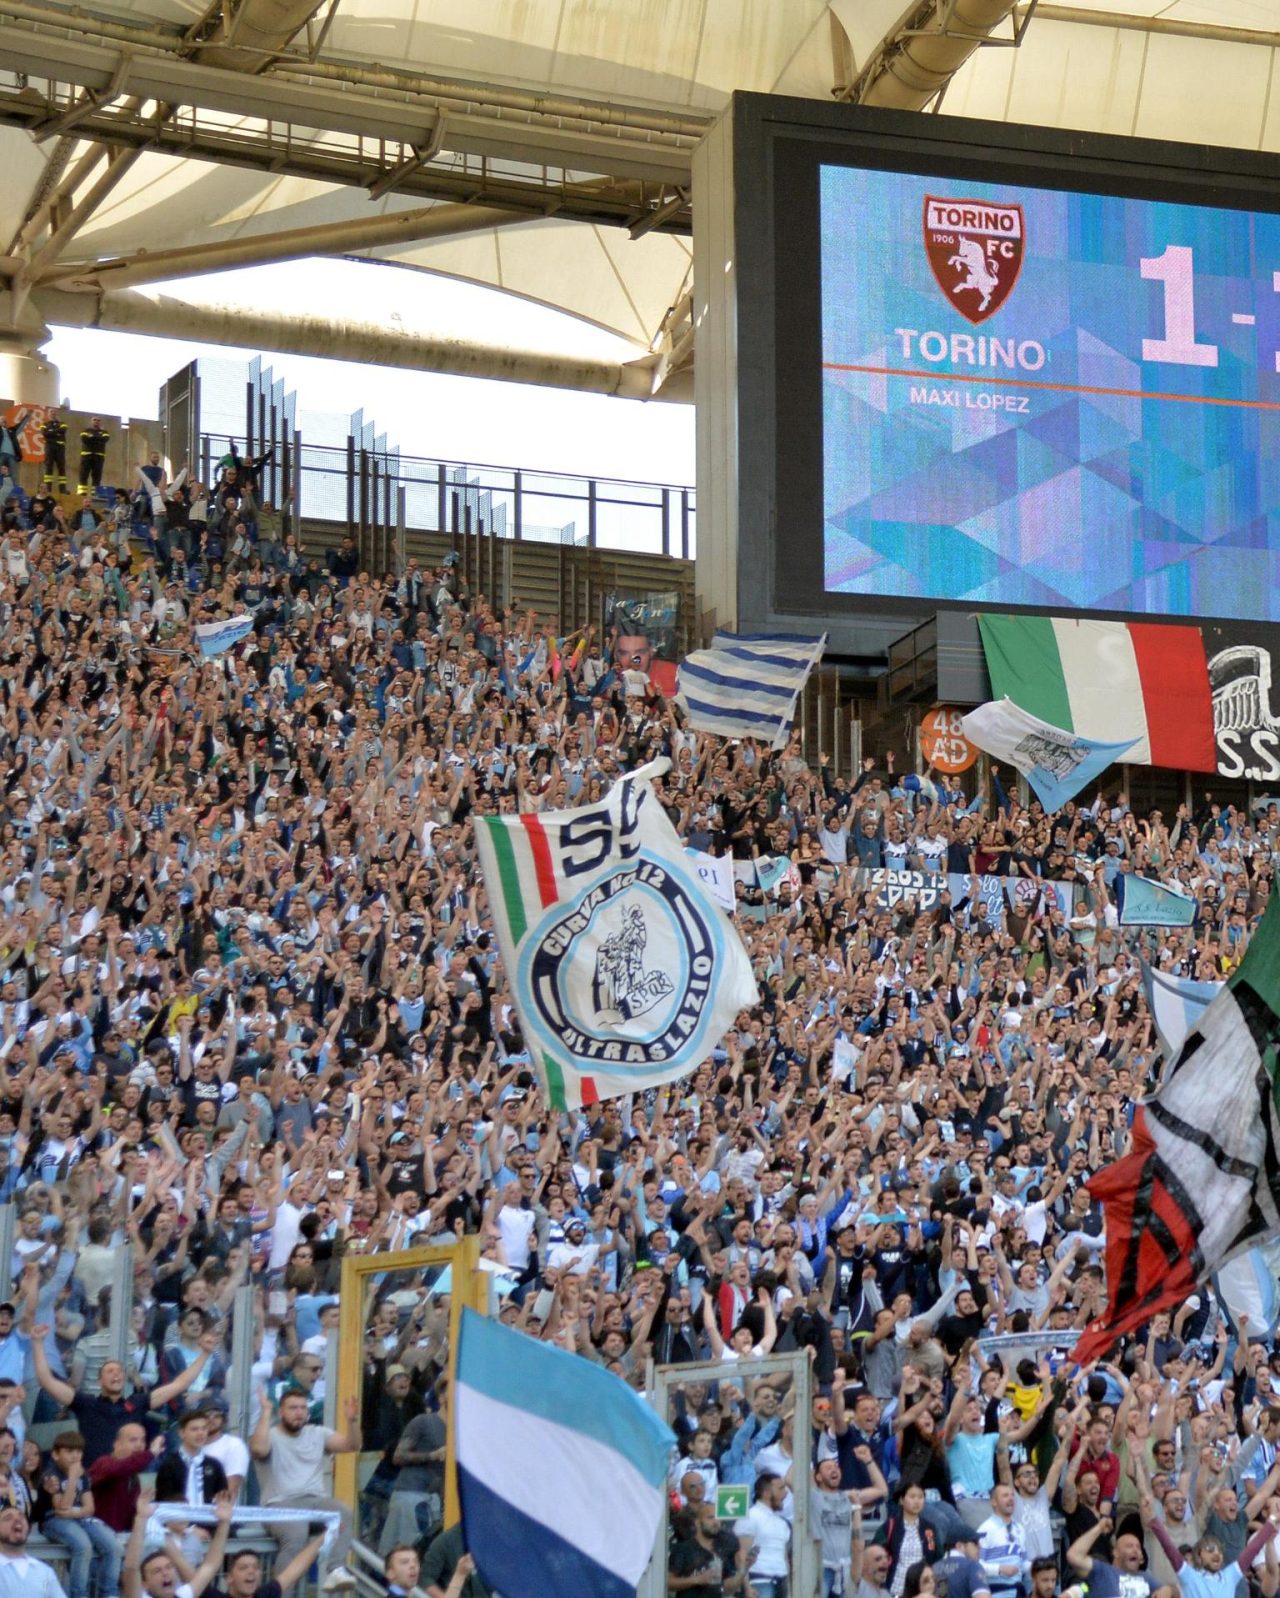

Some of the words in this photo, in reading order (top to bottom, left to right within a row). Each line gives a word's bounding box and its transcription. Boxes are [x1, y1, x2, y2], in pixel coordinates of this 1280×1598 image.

[933, 207, 1014, 232] TORINO
[933, 233, 954, 245] 1906
[986, 239, 1014, 258] FC
[895, 328, 1046, 371] TORINO
[911, 387, 960, 406] MAXI
[965, 391, 1030, 413] LOPEZ
[932, 710, 964, 736] 48
[930, 738, 968, 764] AD
[541, 886, 607, 957] CURVA
